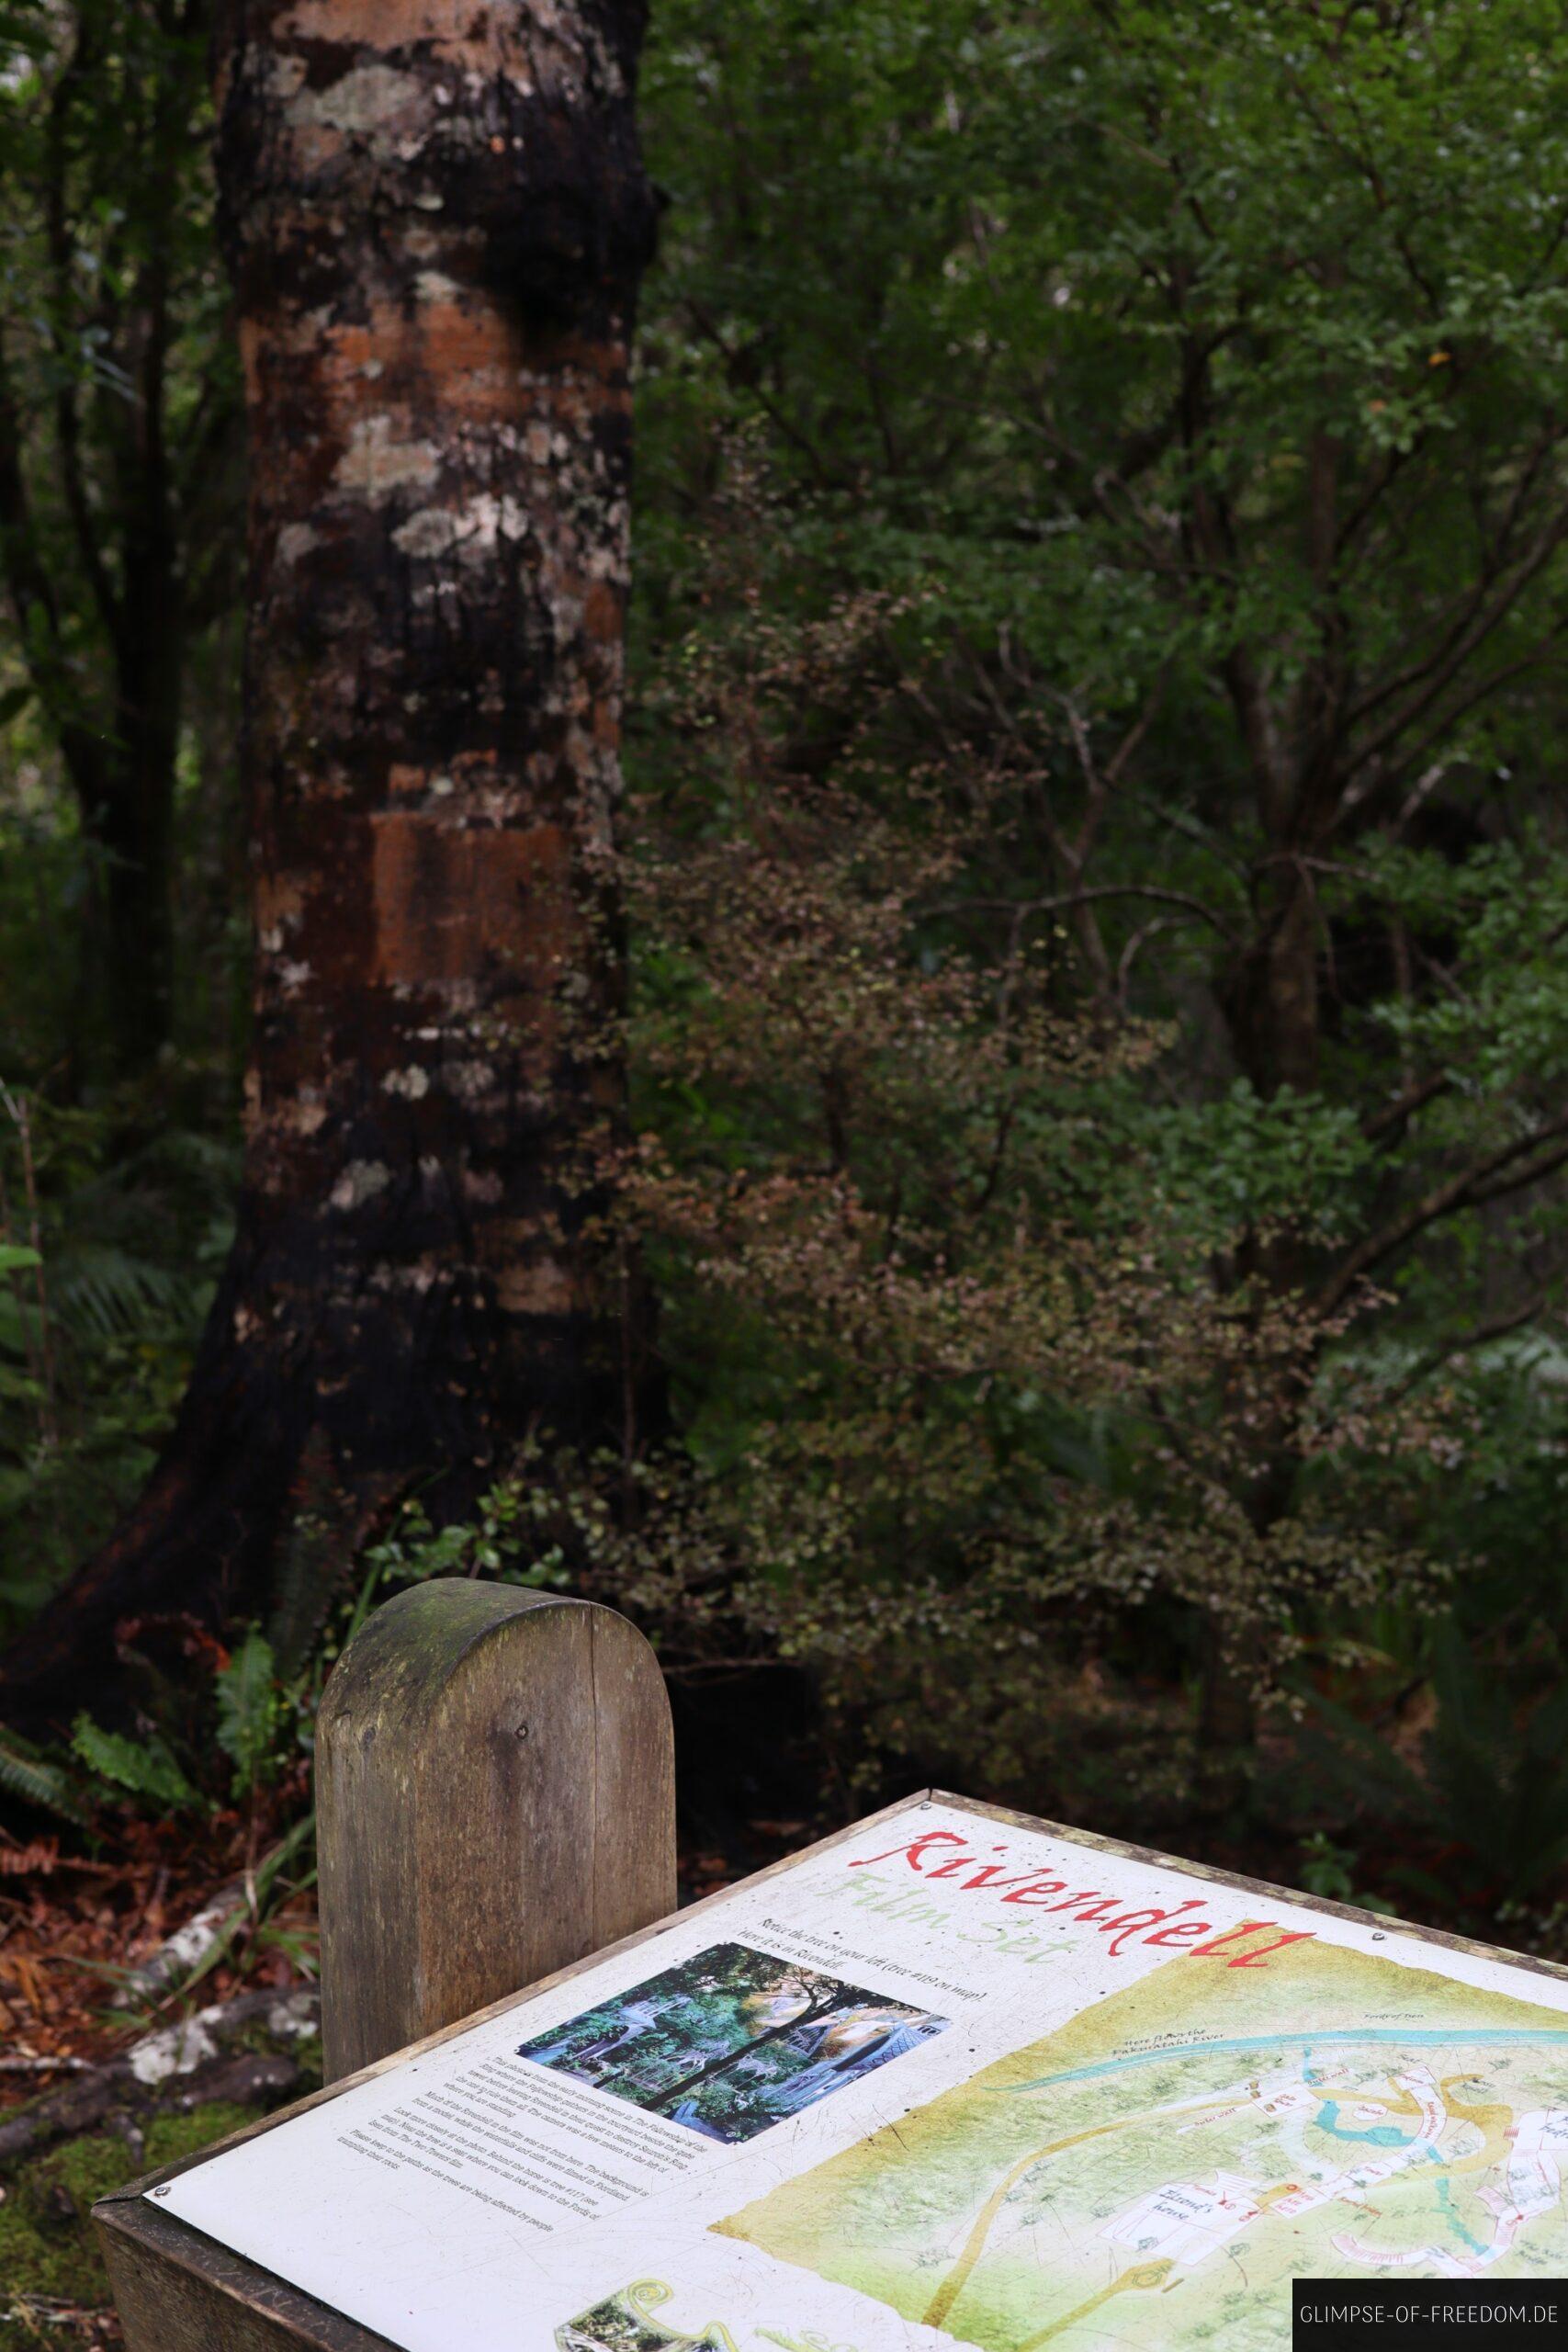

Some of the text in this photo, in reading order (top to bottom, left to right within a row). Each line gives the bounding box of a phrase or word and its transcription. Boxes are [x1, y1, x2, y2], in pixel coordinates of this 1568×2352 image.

[814, 1871, 1082, 1964] Film Set
[847, 1831, 1317, 1968] Rivendell
[737, 1930, 764, 1941] Here
[770, 1940, 784, 1949] is
[781, 1945, 795, 1953] in
[758, 1918, 791, 1934] Notice
[788, 1930, 807, 1939] the
[805, 1936, 828, 1946] tree
[833, 1949, 868, 1960] your
[864, 1956, 889, 1966] left
[881, 1962, 911, 1975] (tree
[910, 1973, 939, 1984] #119
[1124, 2038, 1149, 2047] Here
[1192, 2033, 1224, 2044] River
[444, 2083, 465, 2094] where
[479, 2064, 497, 2073] Ring
[495, 2071, 516, 2081] where
[559, 2100, 589, 2113] gathers
[639, 2133, 665, 2146] beside
[675, 2150, 695, 2159] gate
[486, 2078, 508, 2089] before
[530, 2098, 563, 2113] Rivendell
[568, 2114, 587, 2124] their
[584, 2122, 606, 2132] quest
[613, 2134, 640, 2148] destroy
[492, 2057, 508, 2066] This
[531, 2075, 548, 2084] from
[558, 2086, 578, 2096] early
[575, 2094, 605, 2109] morning
[604, 2107, 626, 2117] scene
[367, 2151, 384, 2161] their
[381, 2127, 399, 2137] from
[425, 2147, 451, 2162] Towers
[393, 2107, 412, 2117] Look
[409, 2115, 427, 2124] more
[487, 2151, 513, 2165] Behind
[523, 2168, 544, 2180] horse
[549, 2181, 566, 2190] tree
[565, 2188, 585, 2198] #117
[412, 2098, 429, 2108] from
[454, 2118, 473, 2128] while
[546, 2160, 565, 2171] were
[563, 2168, 589, 2181] filmed
[424, 2091, 445, 2102] Much
[460, 2108, 493, 2124] Rivendell
[509, 2131, 525, 2139] film
[549, 2149, 568, 2159] from
[598, 2171, 643, 2193] background
[486, 2090, 501, 2098] rule
[499, 2096, 518, 2106] them
[541, 2115, 566, 2128] camera
[599, 2141, 626, 2154] meters
[644, 2160, 660, 2169] left
[369, 2140, 388, 2150] keep
[401, 2157, 424, 2168] paths
[443, 2176, 461, 2186] trees
[470, 2189, 492, 2202] being
[491, 2200, 521, 2215] affected
[526, 2218, 553, 2232] people
[399, 2122, 417, 2132] Near
[425, 2134, 441, 2144] tree
[450, 2148, 468, 2157] seat
[466, 2154, 489, 2166] where
[513, 2177, 529, 2187] look
[527, 2185, 548, 2196] down
[568, 2203, 591, 2216] Fords
[1153, 2201, 1190, 2220] house
